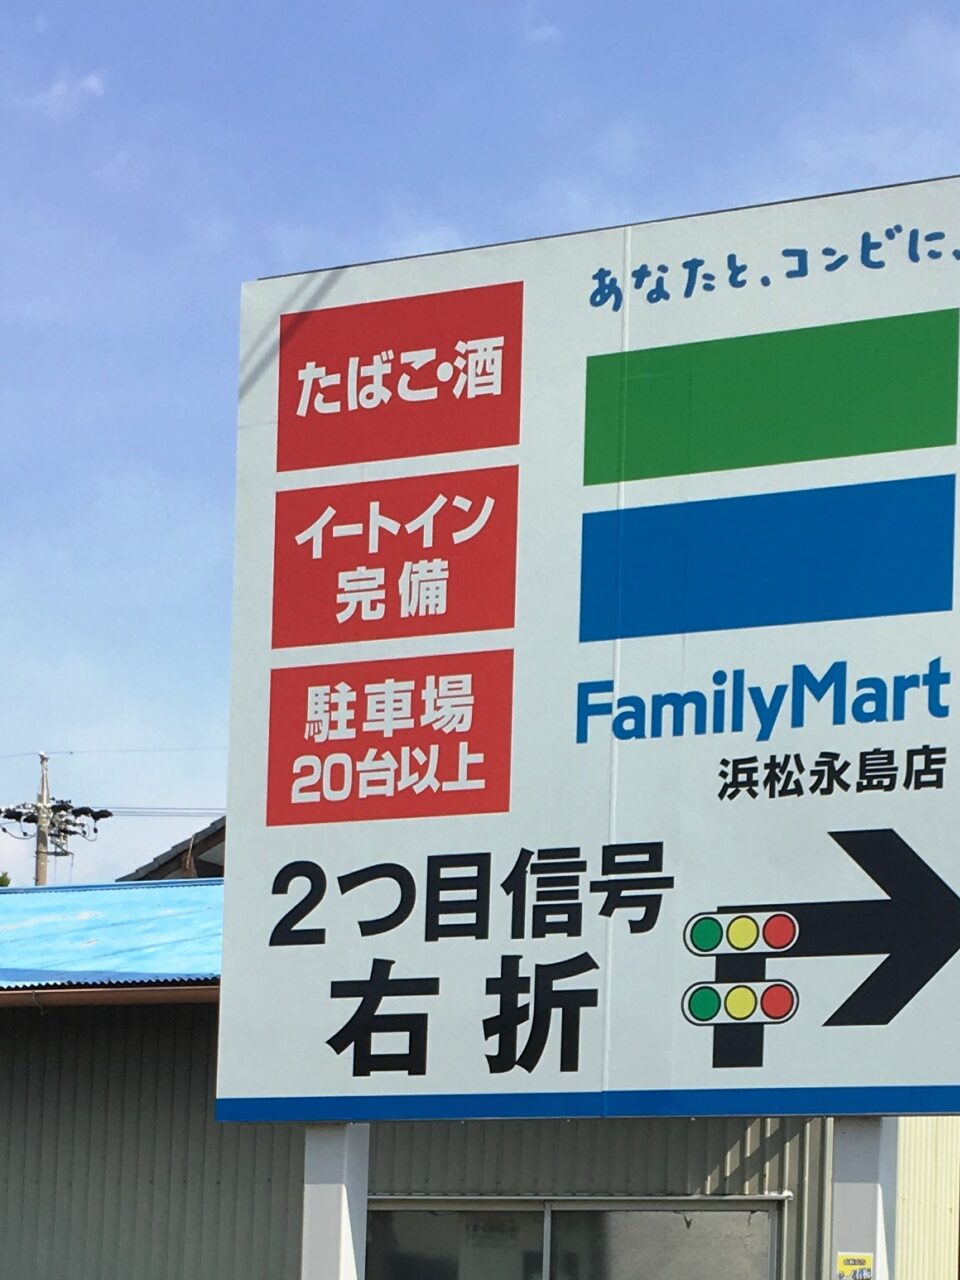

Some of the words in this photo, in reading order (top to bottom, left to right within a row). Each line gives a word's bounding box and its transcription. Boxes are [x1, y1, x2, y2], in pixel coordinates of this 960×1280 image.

[296, 335, 505, 417] たばこ・酒
[294, 493, 497, 560] イートイン
[335, 559, 450, 623] 完備
[304, 674, 476, 743] 駐車場
[575, 656, 951, 745] FamilyMart
[291, 743, 487, 804] 20台以上
[717, 744, 948, 802] 浜松永島店
[268, 841, 675, 947] 2つ目信号
[326, 951, 600, 1077] 右折
